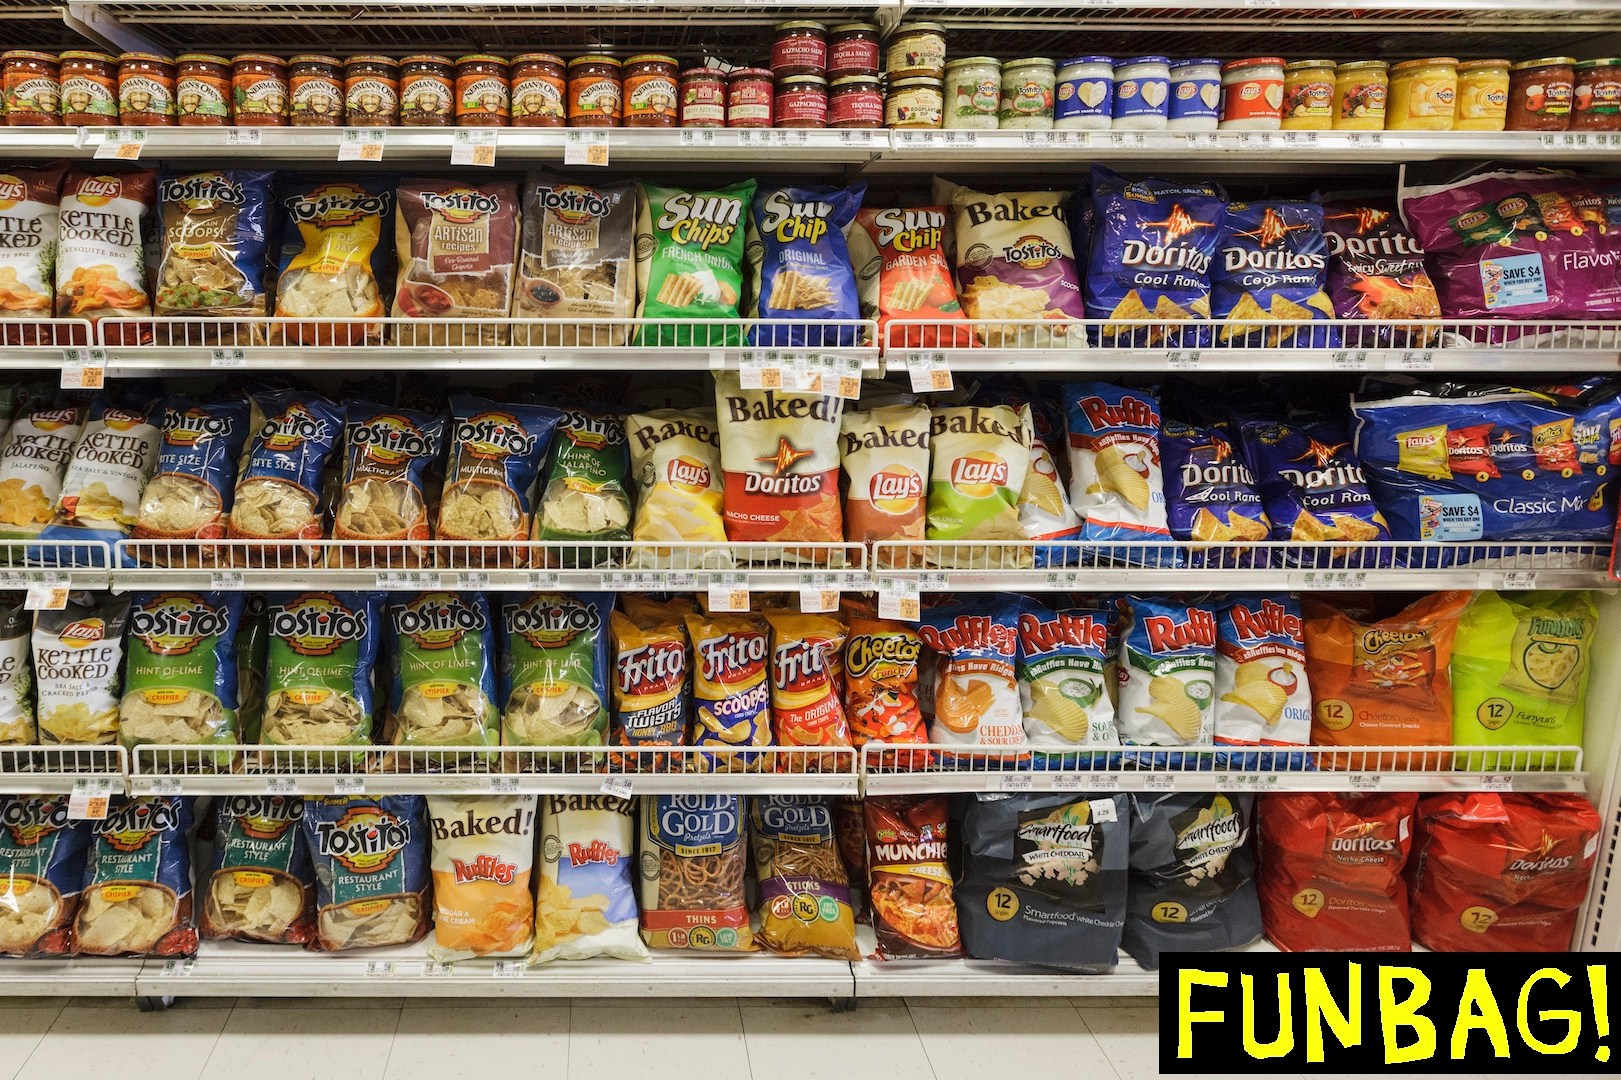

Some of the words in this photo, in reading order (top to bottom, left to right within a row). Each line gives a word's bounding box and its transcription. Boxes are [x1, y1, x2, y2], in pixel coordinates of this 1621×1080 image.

[78, 178, 120, 200] Lay's
[671, 218, 735, 252] Chips
[441, 242, 476, 254] recipes
[661, 246, 701, 263] FRENCH
[779, 248, 826, 266] ORIGINAL
[885, 256, 928, 273] GARDEN
[1222, 244, 1326, 272] Doritos
[1134, 272, 1168, 285] Cool
[1503, 267, 1526, 281] SAVE
[1528, 265, 1541, 279] $4
[724, 389, 841, 426] Baked!
[669, 457, 711, 487] Lay's
[953, 458, 1009, 484] Lay's
[744, 471, 823, 495] Doritos
[872, 474, 922, 502] Lay's
[1442, 506, 1466, 518] SAVE
[1467, 505, 1480, 518] $4
[1493, 497, 1557, 515] Classic
[749, 513, 780, 523] CHEESE
[136, 665, 159, 677] HINT
[409, 661, 430, 673] HINT
[433, 660, 447, 671] OF
[448, 658, 471, 670] LIME
[523, 659, 544, 672] HINT
[967, 661, 988, 673] Have
[1068, 657, 1090, 670] Have
[151, 693, 180, 702] CRISPIER
[790, 712, 803, 724] The
[1323, 703, 1345, 719] 12
[1486, 702, 1503, 719] 12
[432, 807, 533, 842] Baked!
[661, 809, 737, 838] GOLD
[764, 806, 831, 829] GOLD
[683, 831, 713, 844] Pretzels
[1331, 835, 1396, 854] Doritos
[243, 851, 270, 862] STYLE
[568, 838, 621, 871] Ruffles
[680, 847, 700, 856] SINCE
[701, 846, 716, 855] 1917
[1029, 851, 1050, 863] WHITE
[1050, 849, 1085, 861] CHEDDAR
[101, 853, 152, 866] RESTAURANT
[1358, 854, 1385, 866] Cheese
[338, 868, 399, 887] RESTAURANT
[452, 853, 519, 887] Ruffles
[908, 867, 942, 879] CHEESE
[239, 877, 266, 886] CRISPIER
[355, 882, 383, 893] STYLE
[785, 881, 821, 893] STICKS
[104, 890, 132, 899] CRISPIER
[994, 893, 1011, 910] 12
[1299, 893, 1318, 907] 12
[355, 902, 385, 914] CRISPIER
[1024, 904, 1076, 922] Smartfood
[1160, 906, 1179, 921] 12
[686, 914, 717, 925] THINS
[1470, 912, 1487, 926] 12
